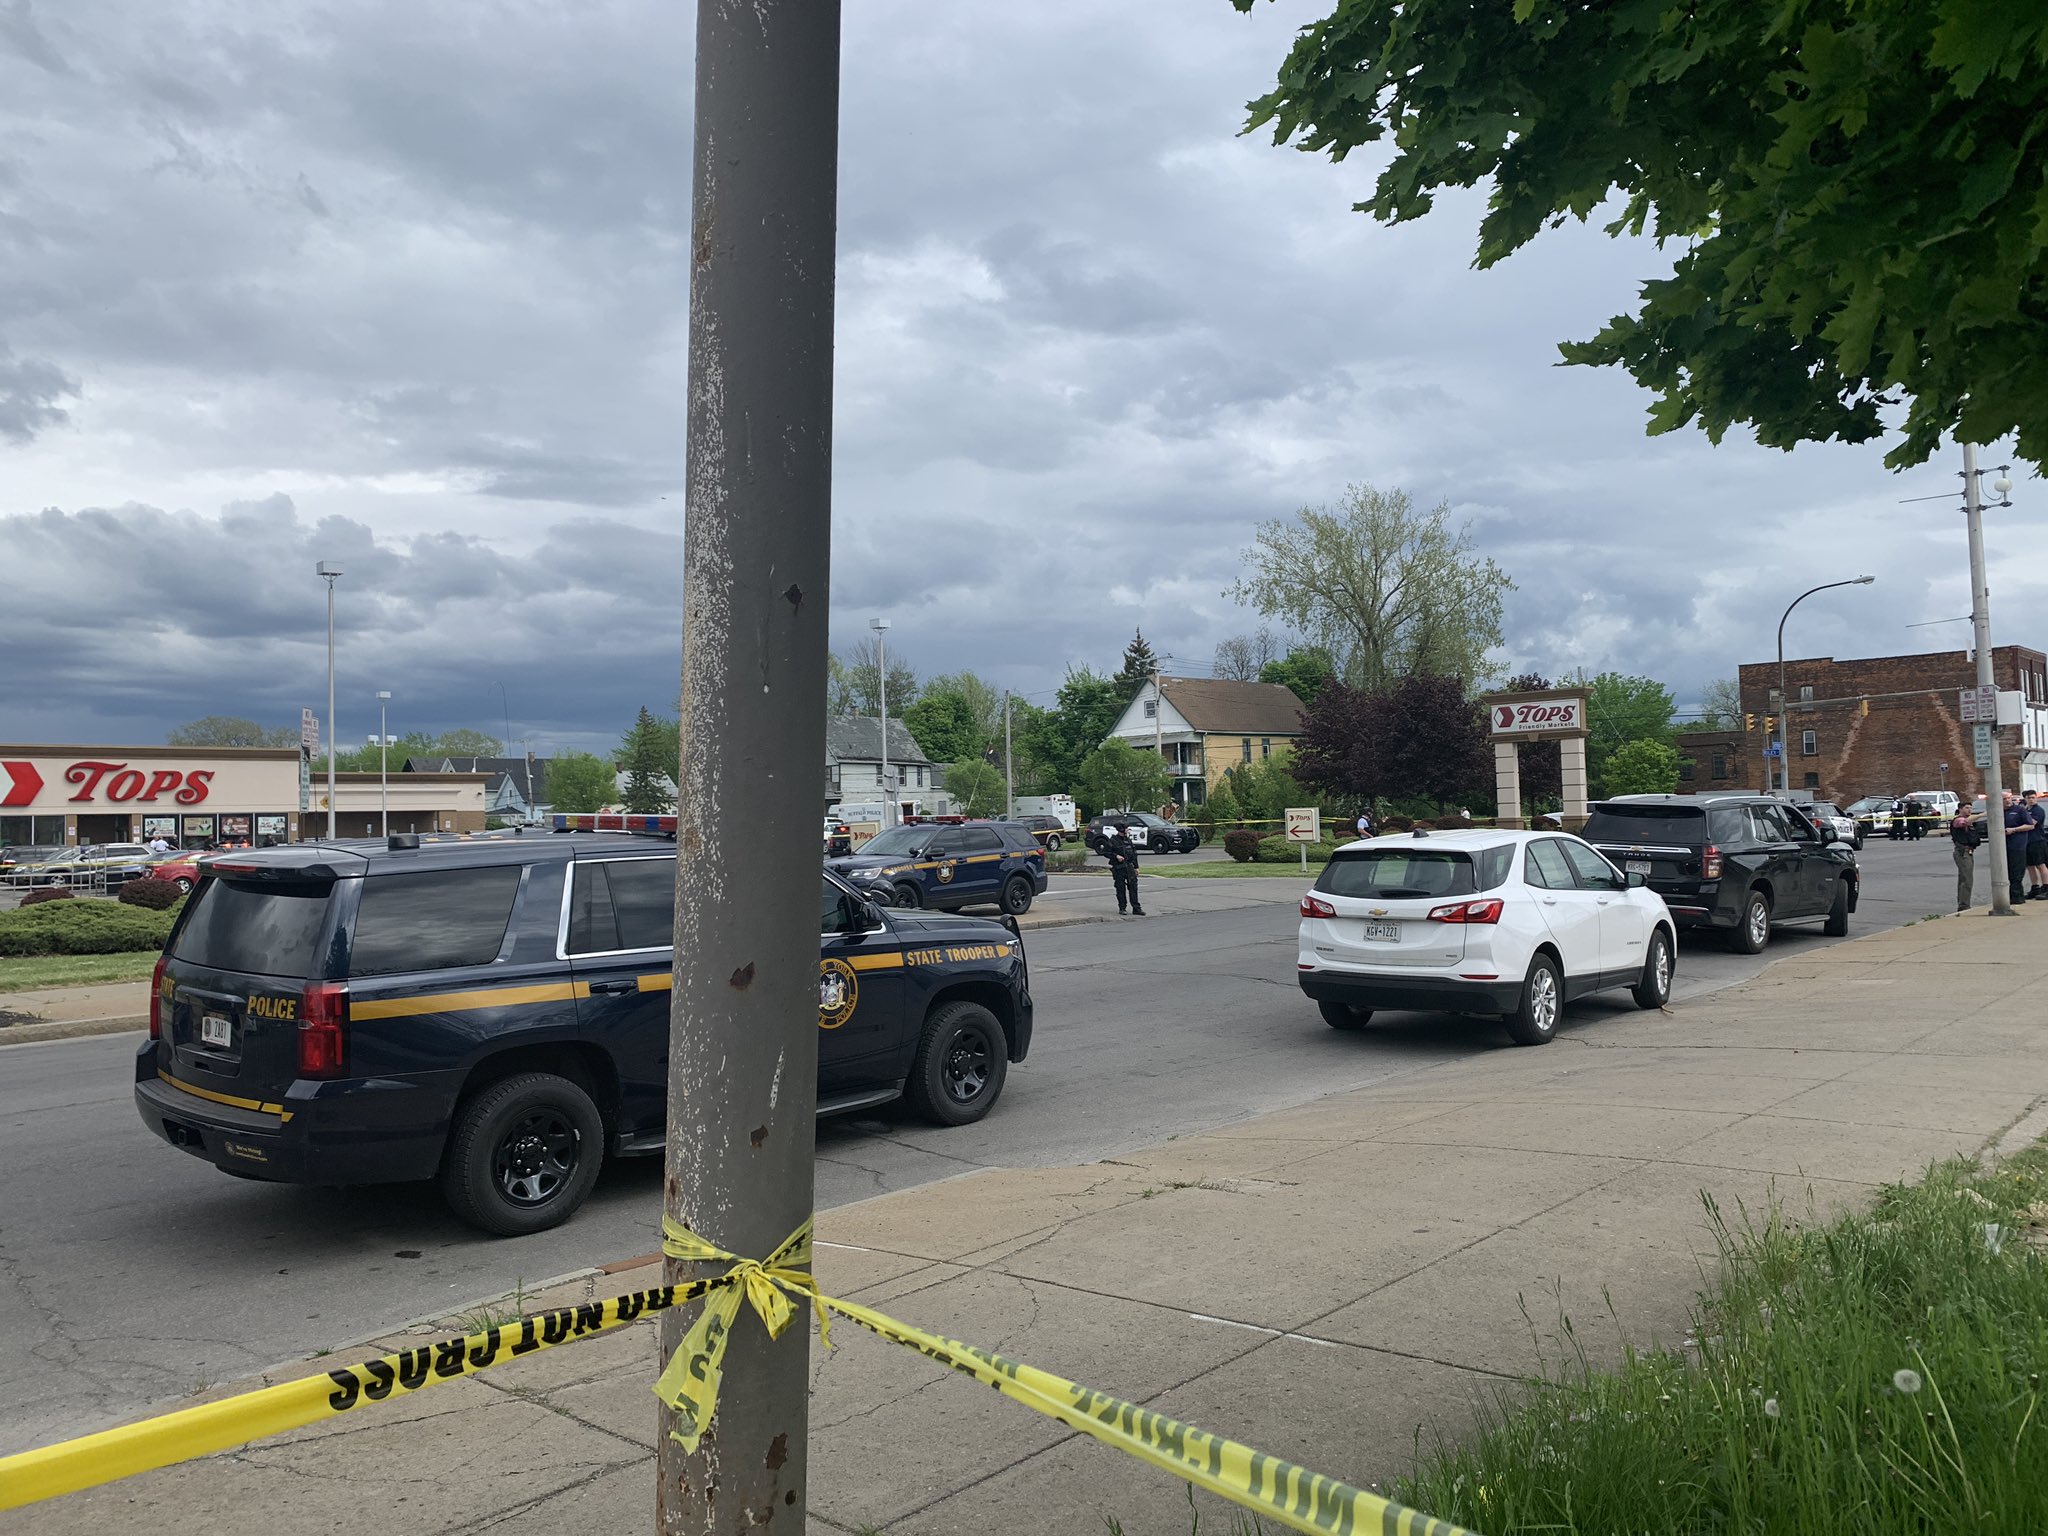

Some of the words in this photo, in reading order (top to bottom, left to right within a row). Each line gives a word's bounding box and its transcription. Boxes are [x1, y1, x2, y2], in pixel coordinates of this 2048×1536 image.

[907, 951, 943, 967] STATE
[946, 945, 995, 963] TROOPER
[247, 995, 297, 1020] POLICE
